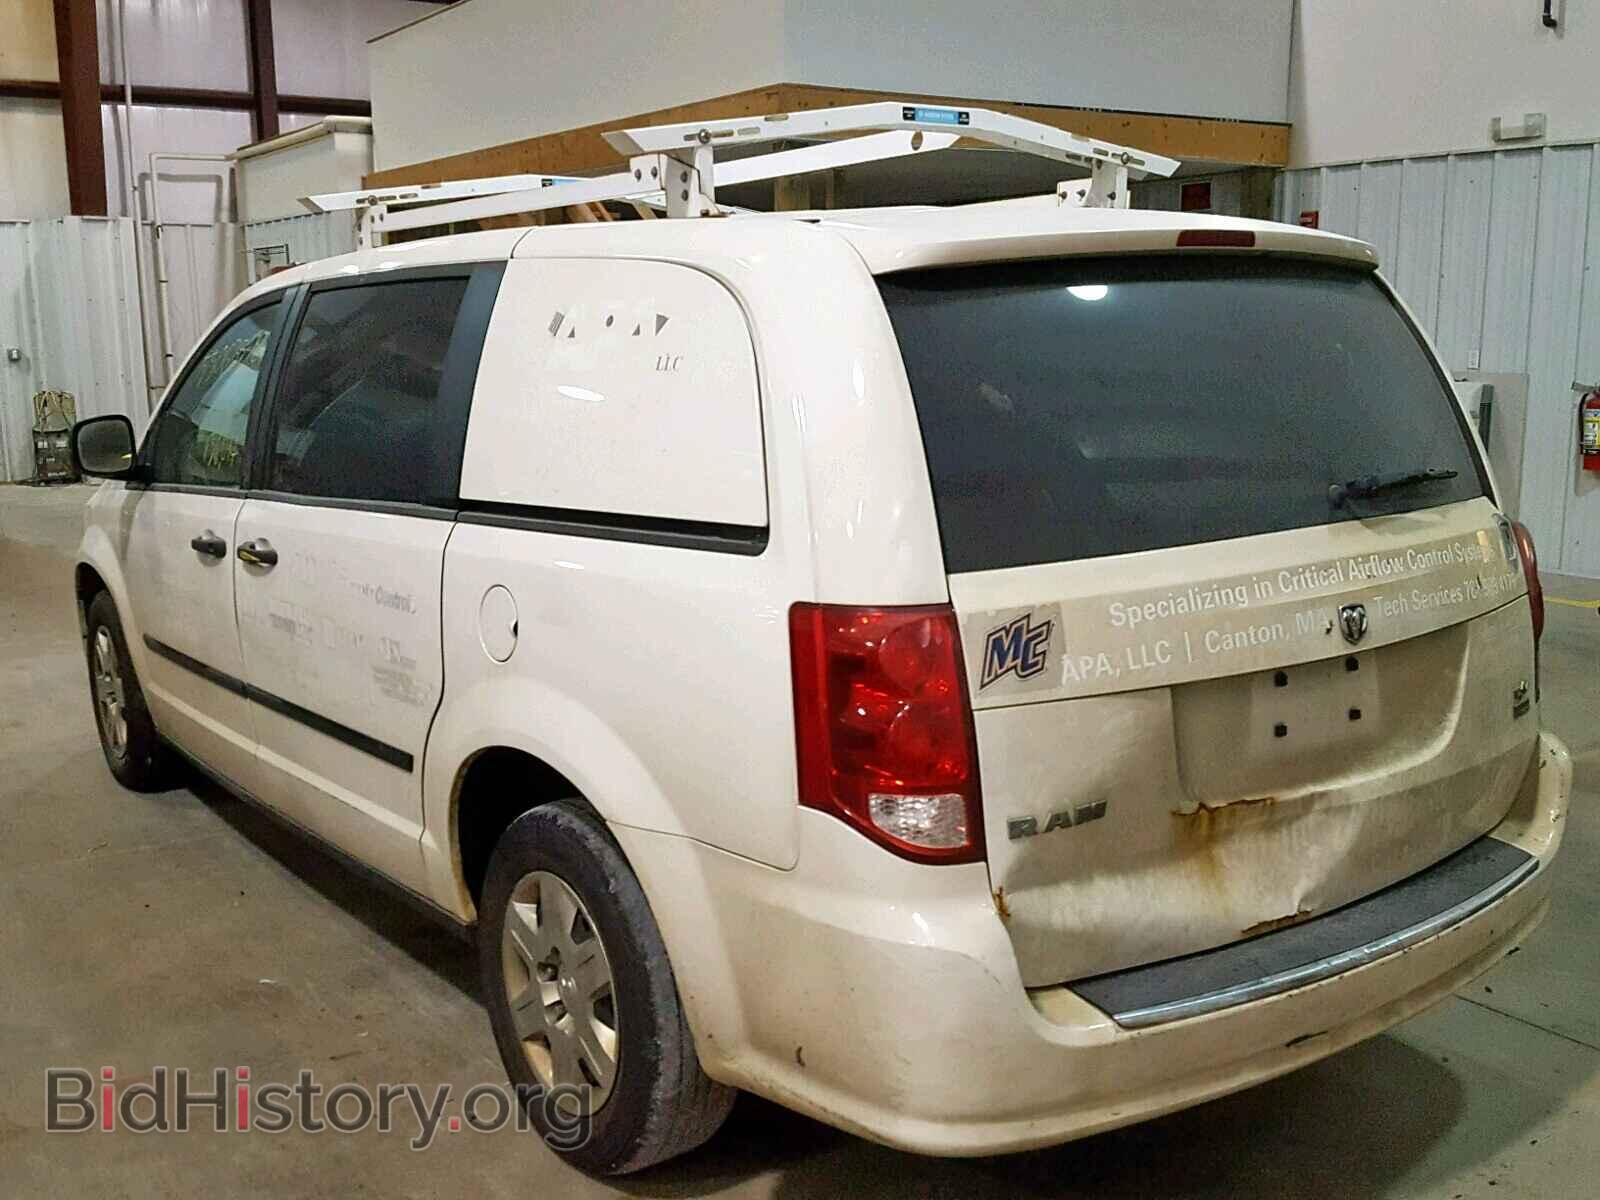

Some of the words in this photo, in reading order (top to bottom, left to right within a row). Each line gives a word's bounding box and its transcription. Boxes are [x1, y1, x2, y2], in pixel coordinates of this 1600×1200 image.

[1109, 583, 1249, 630] Specializing
[1252, 576, 1273, 599] in
[1279, 561, 1344, 593] Critical
[1348, 554, 1404, 580] Airflow
[1407, 543, 1453, 570] Control
[979, 612, 1053, 690] MC
[1061, 652, 1120, 686] APA,
[1126, 640, 1172, 670] LLC
[1204, 622, 1290, 654] Canton,
[1372, 593, 1408, 618] Tech
[1411, 585, 1464, 611] Services
[1006, 799, 1108, 841] RAM
